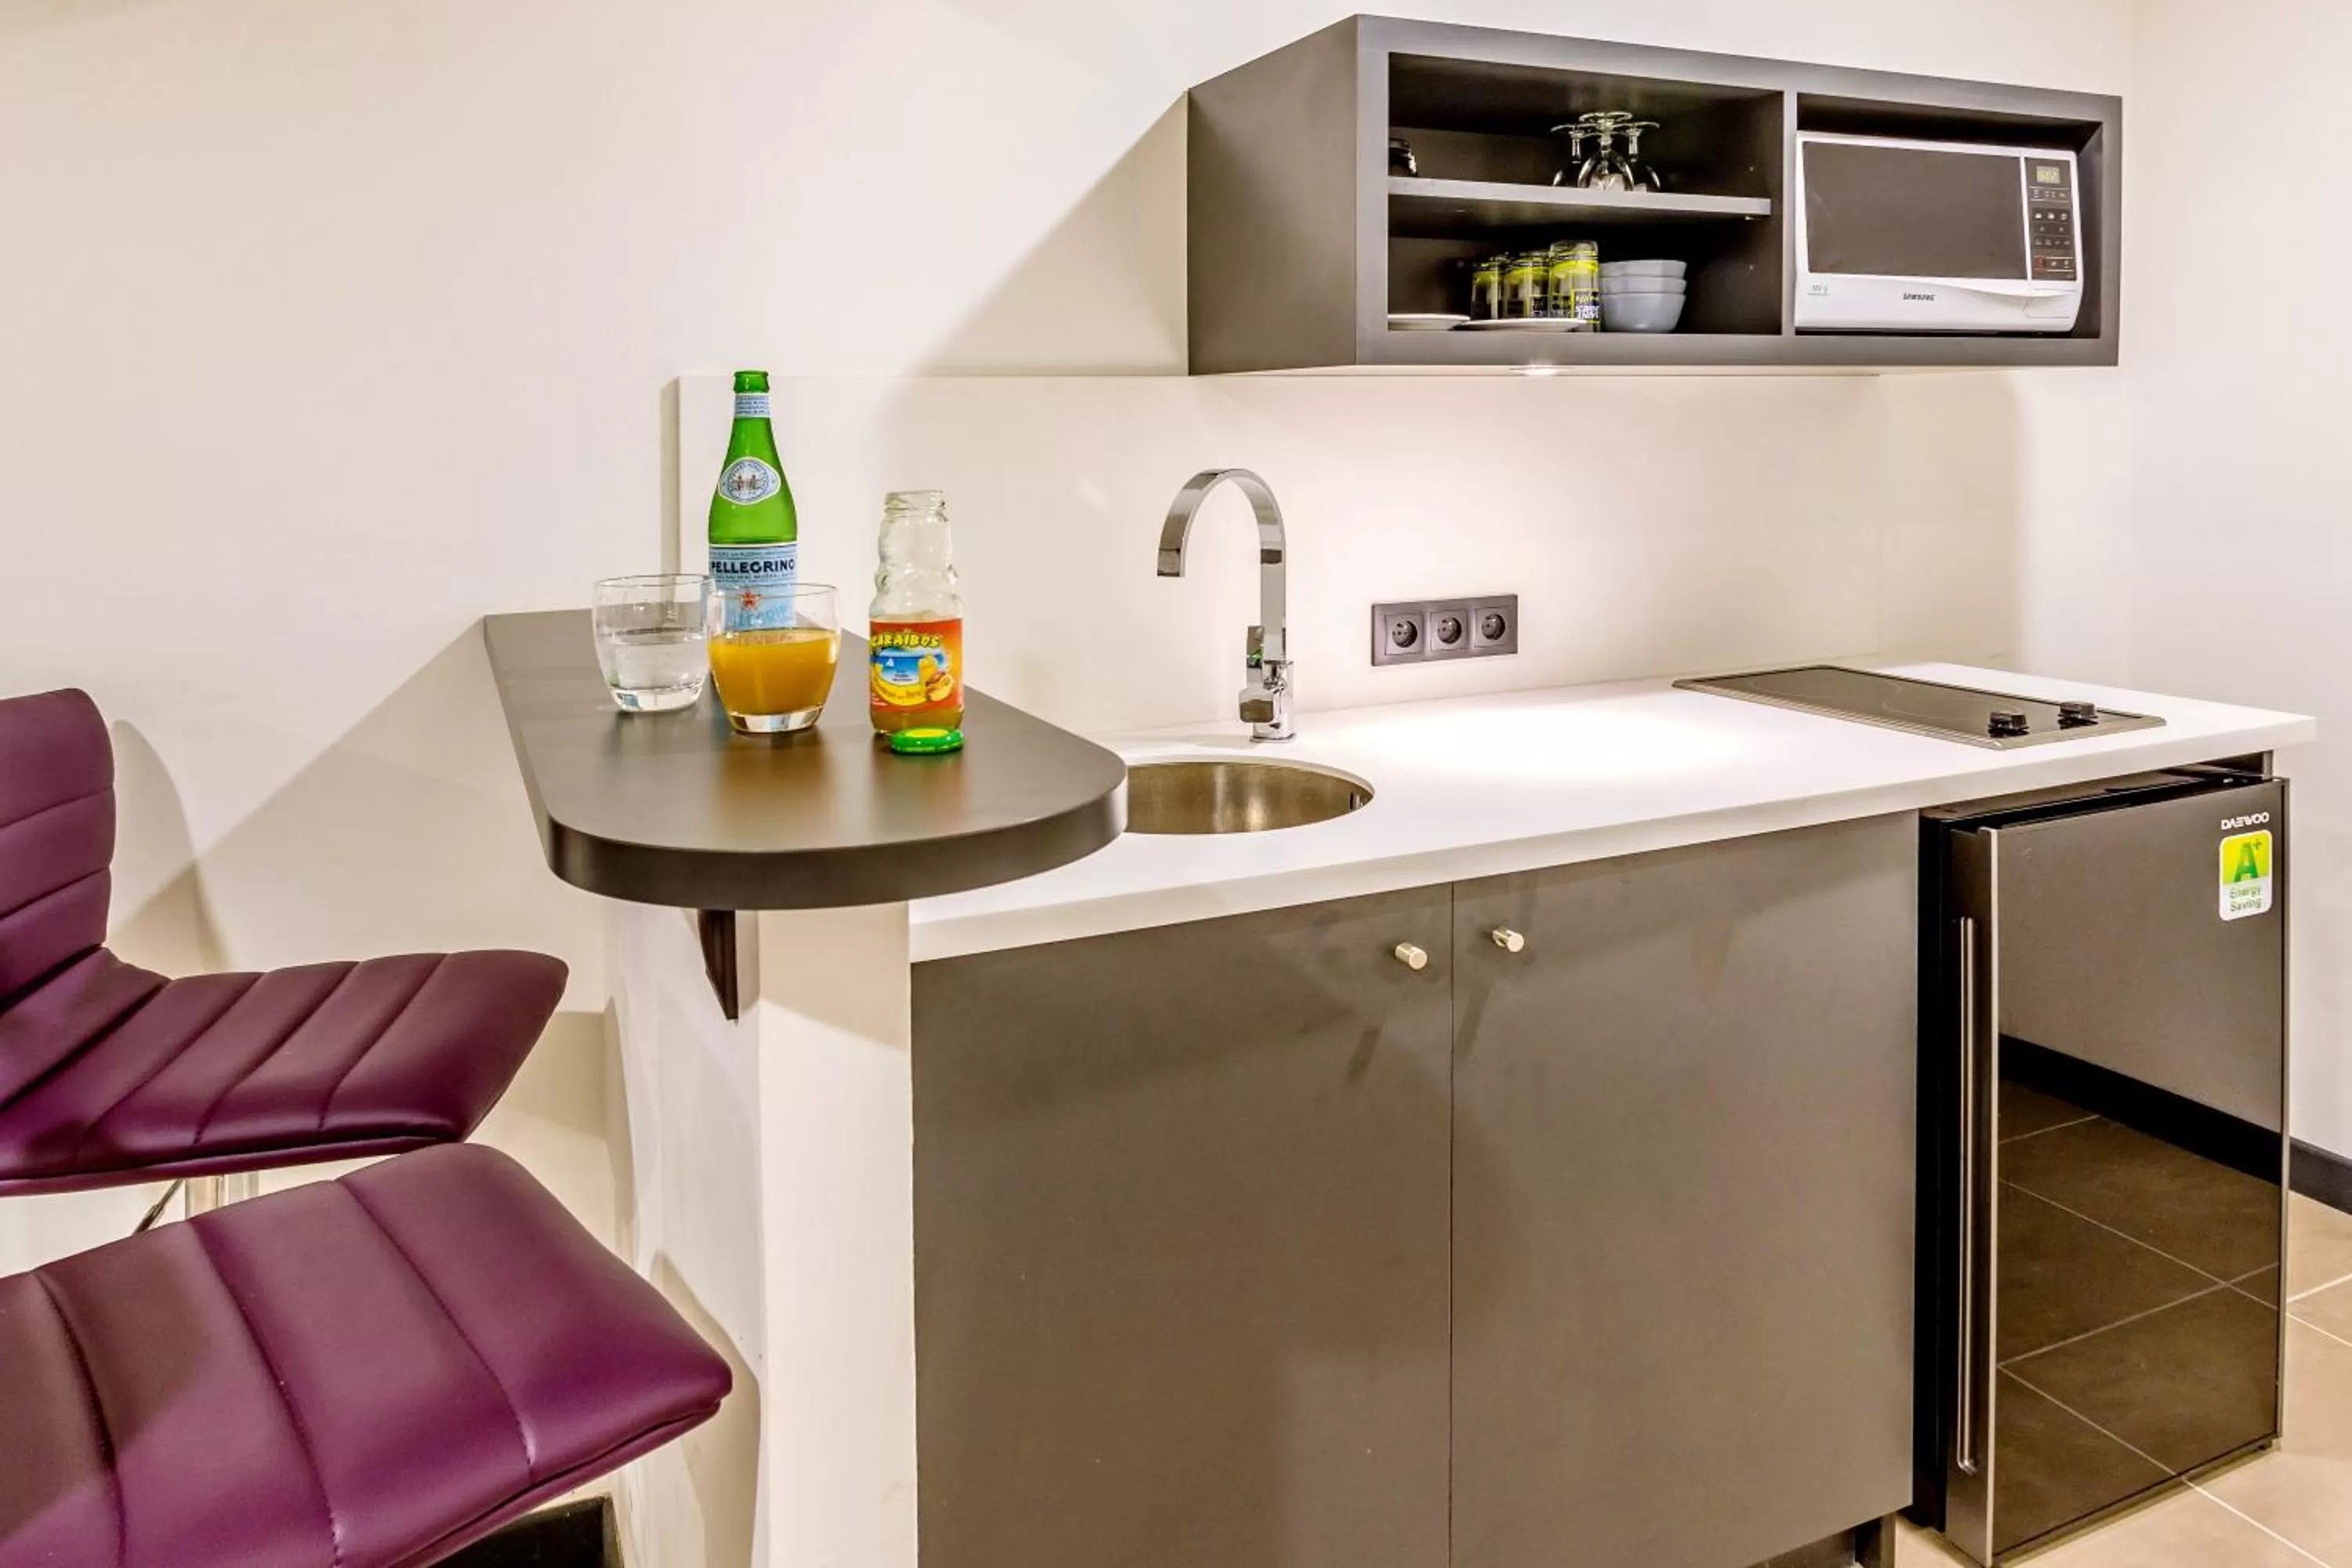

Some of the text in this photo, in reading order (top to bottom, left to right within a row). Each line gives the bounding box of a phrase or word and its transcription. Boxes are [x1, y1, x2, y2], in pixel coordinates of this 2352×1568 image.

[2220, 811, 2270, 830] DAEWOO
[2229, 885, 2262, 899] Energy
[2230, 898, 2262, 913] Saving
